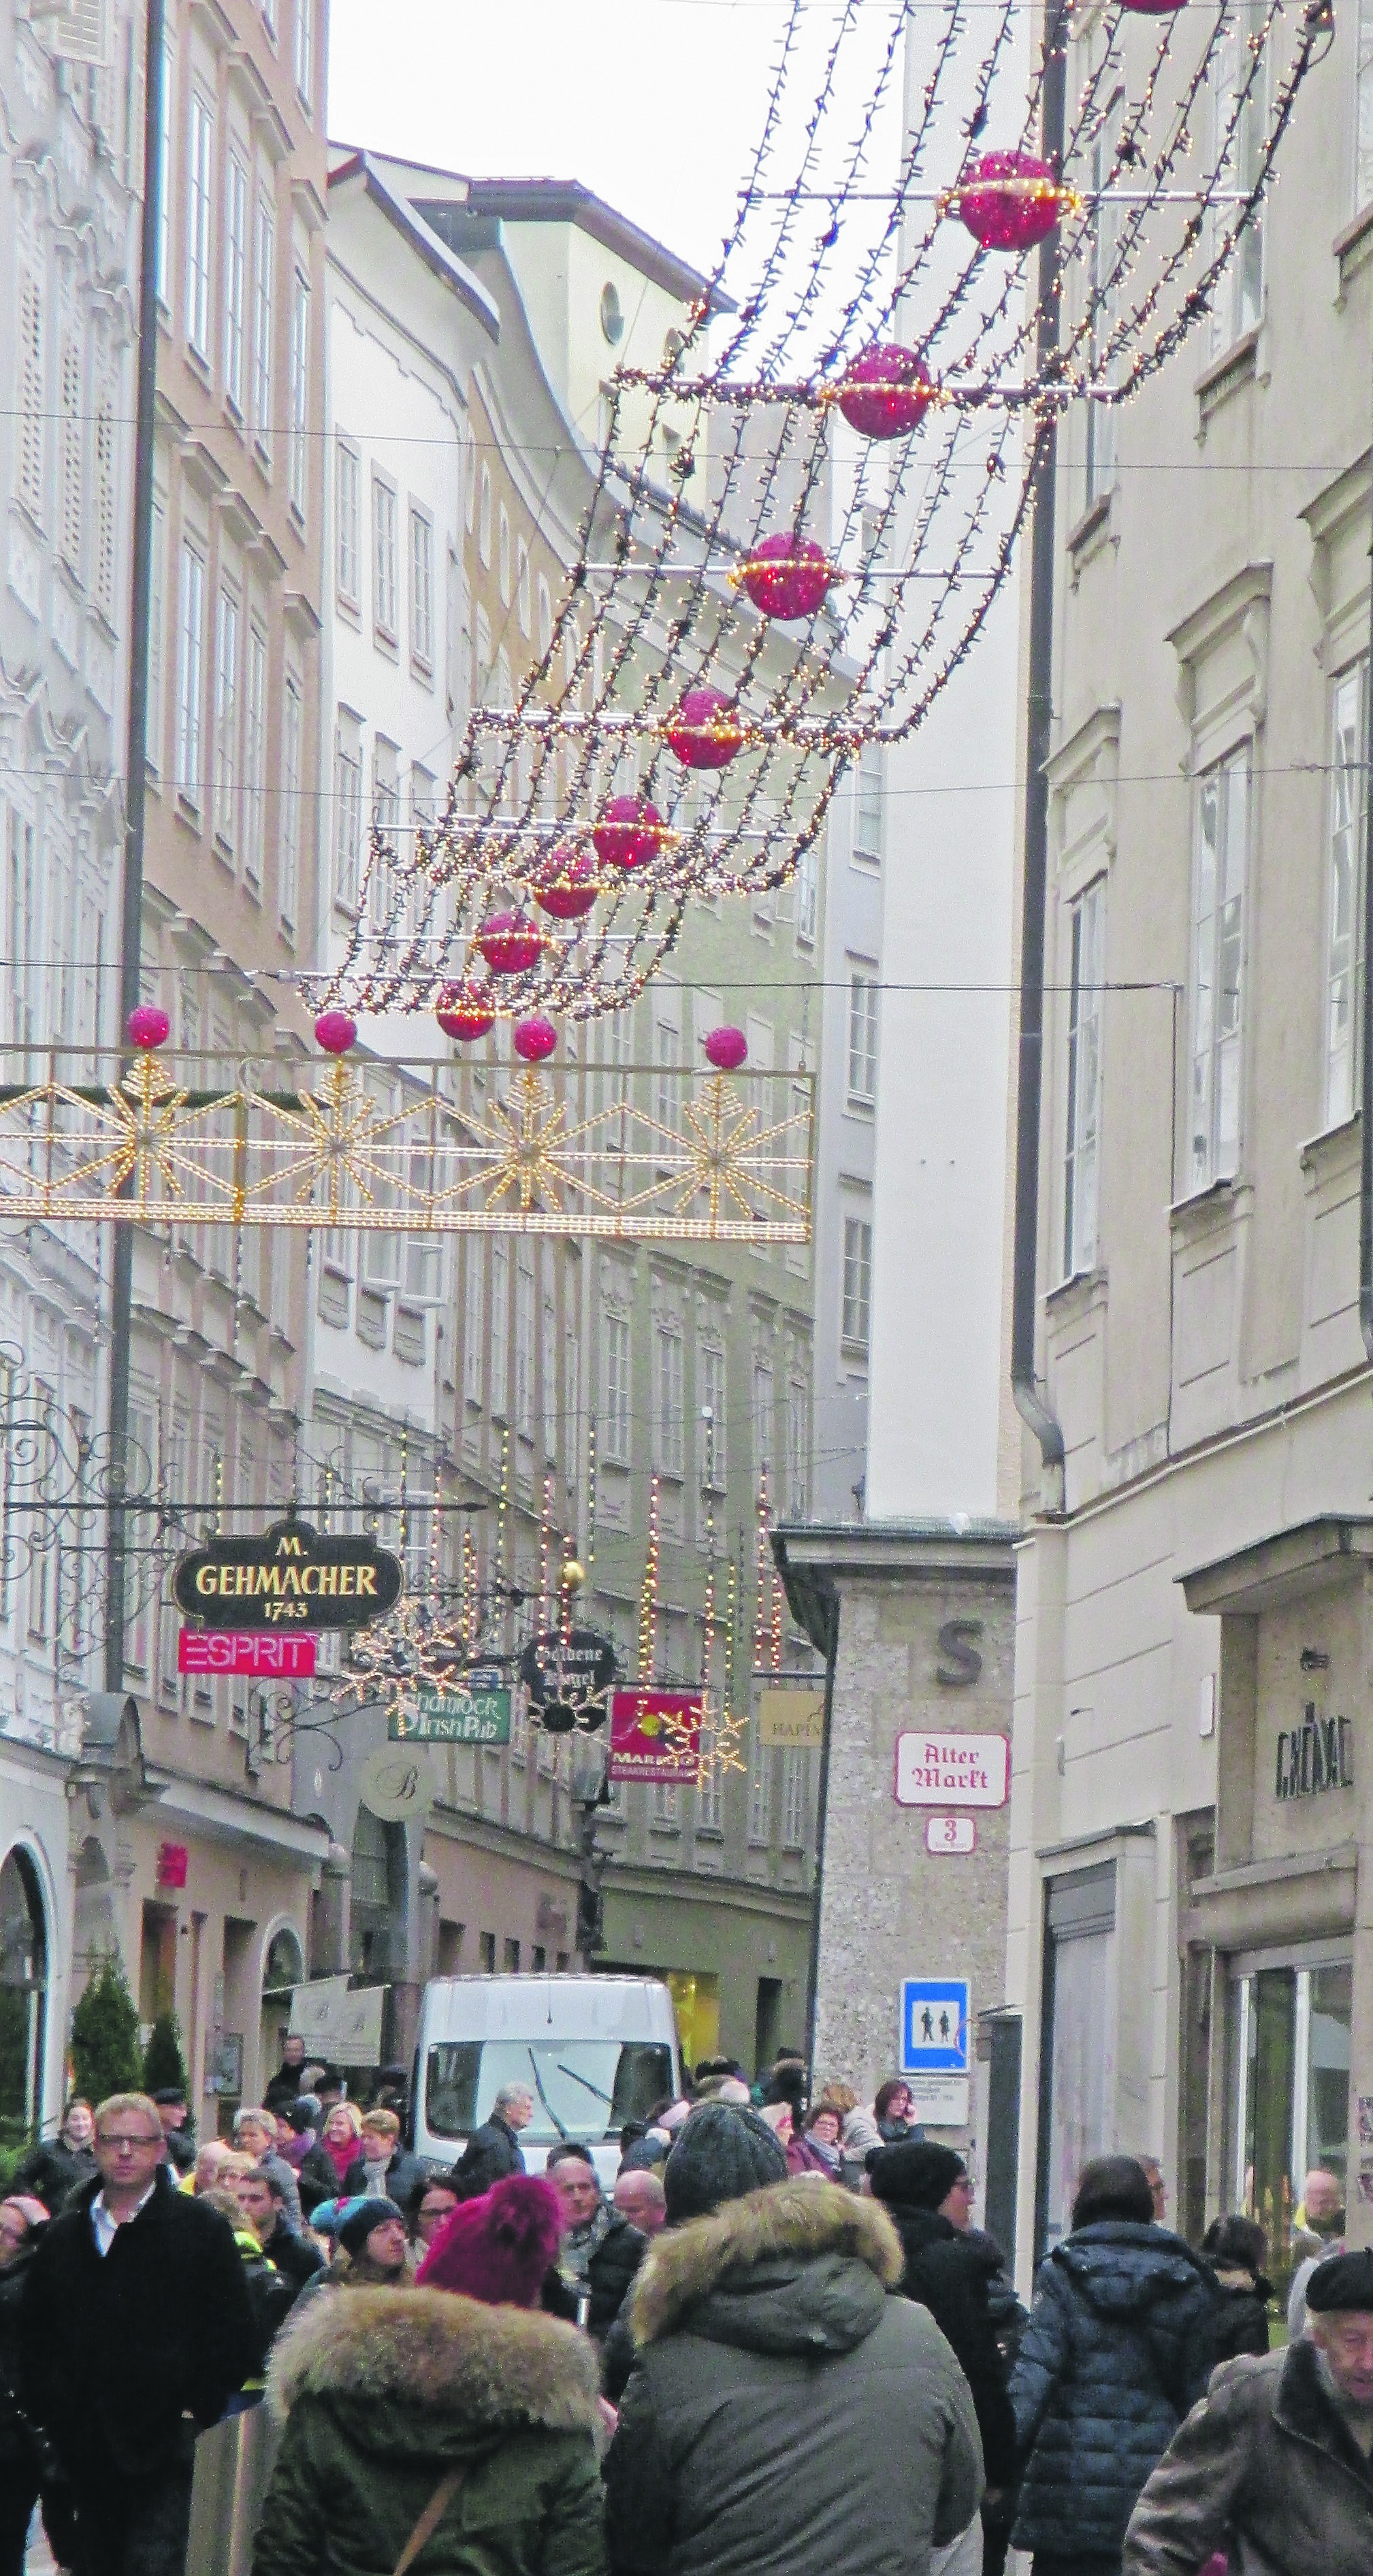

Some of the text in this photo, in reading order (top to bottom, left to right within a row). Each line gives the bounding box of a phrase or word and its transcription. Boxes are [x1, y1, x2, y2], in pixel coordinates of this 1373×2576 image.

[275, 1536, 310, 1557] M.
[195, 1565, 378, 1597] GEHMACHER
[263, 1601, 308, 1622] 1743
[186, 1635, 307, 1669] ESPRIT
[924, 1742, 980, 1765] Alter
[911, 1767, 988, 1789] Markt
[944, 1819, 957, 1842] 3
